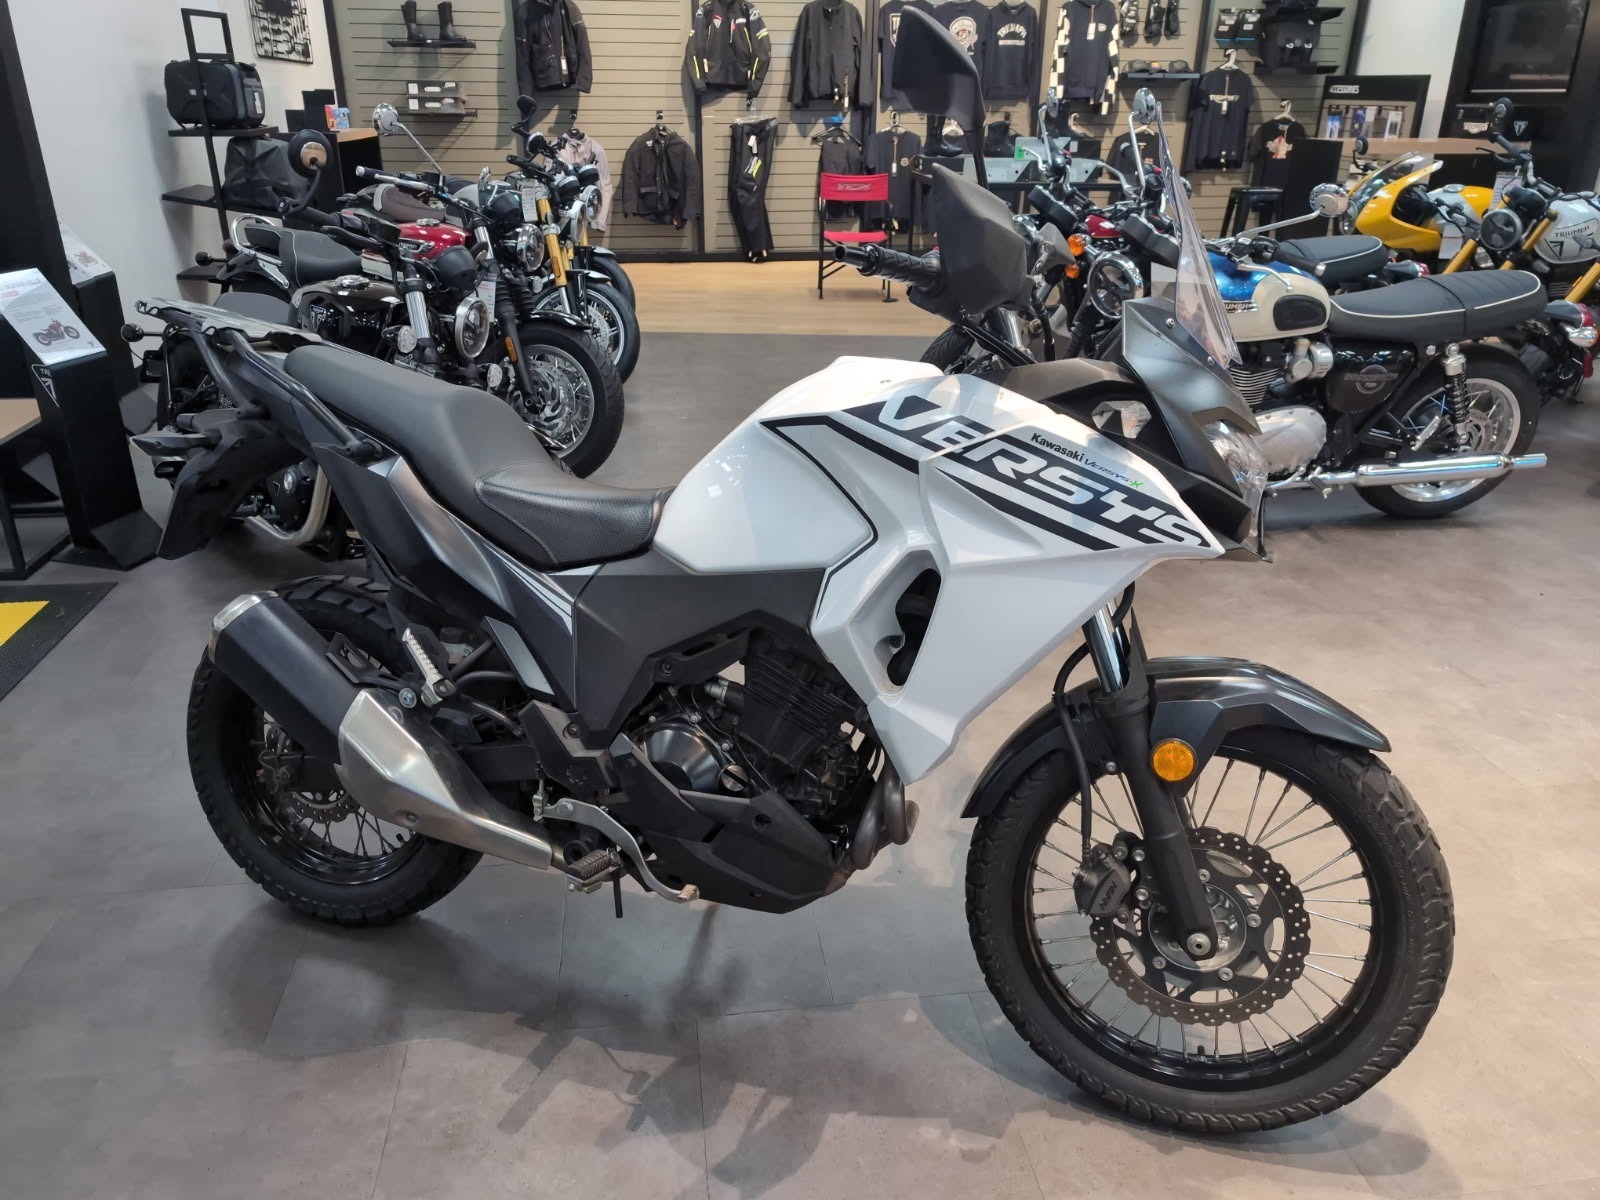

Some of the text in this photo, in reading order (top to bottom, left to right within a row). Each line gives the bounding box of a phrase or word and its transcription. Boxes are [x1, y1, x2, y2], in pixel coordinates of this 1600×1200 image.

[1555, 225, 1590, 237] TRIUMPH
[1031, 432, 1085, 462] Kawasaki
[878, 381, 1203, 547] VERSYS
